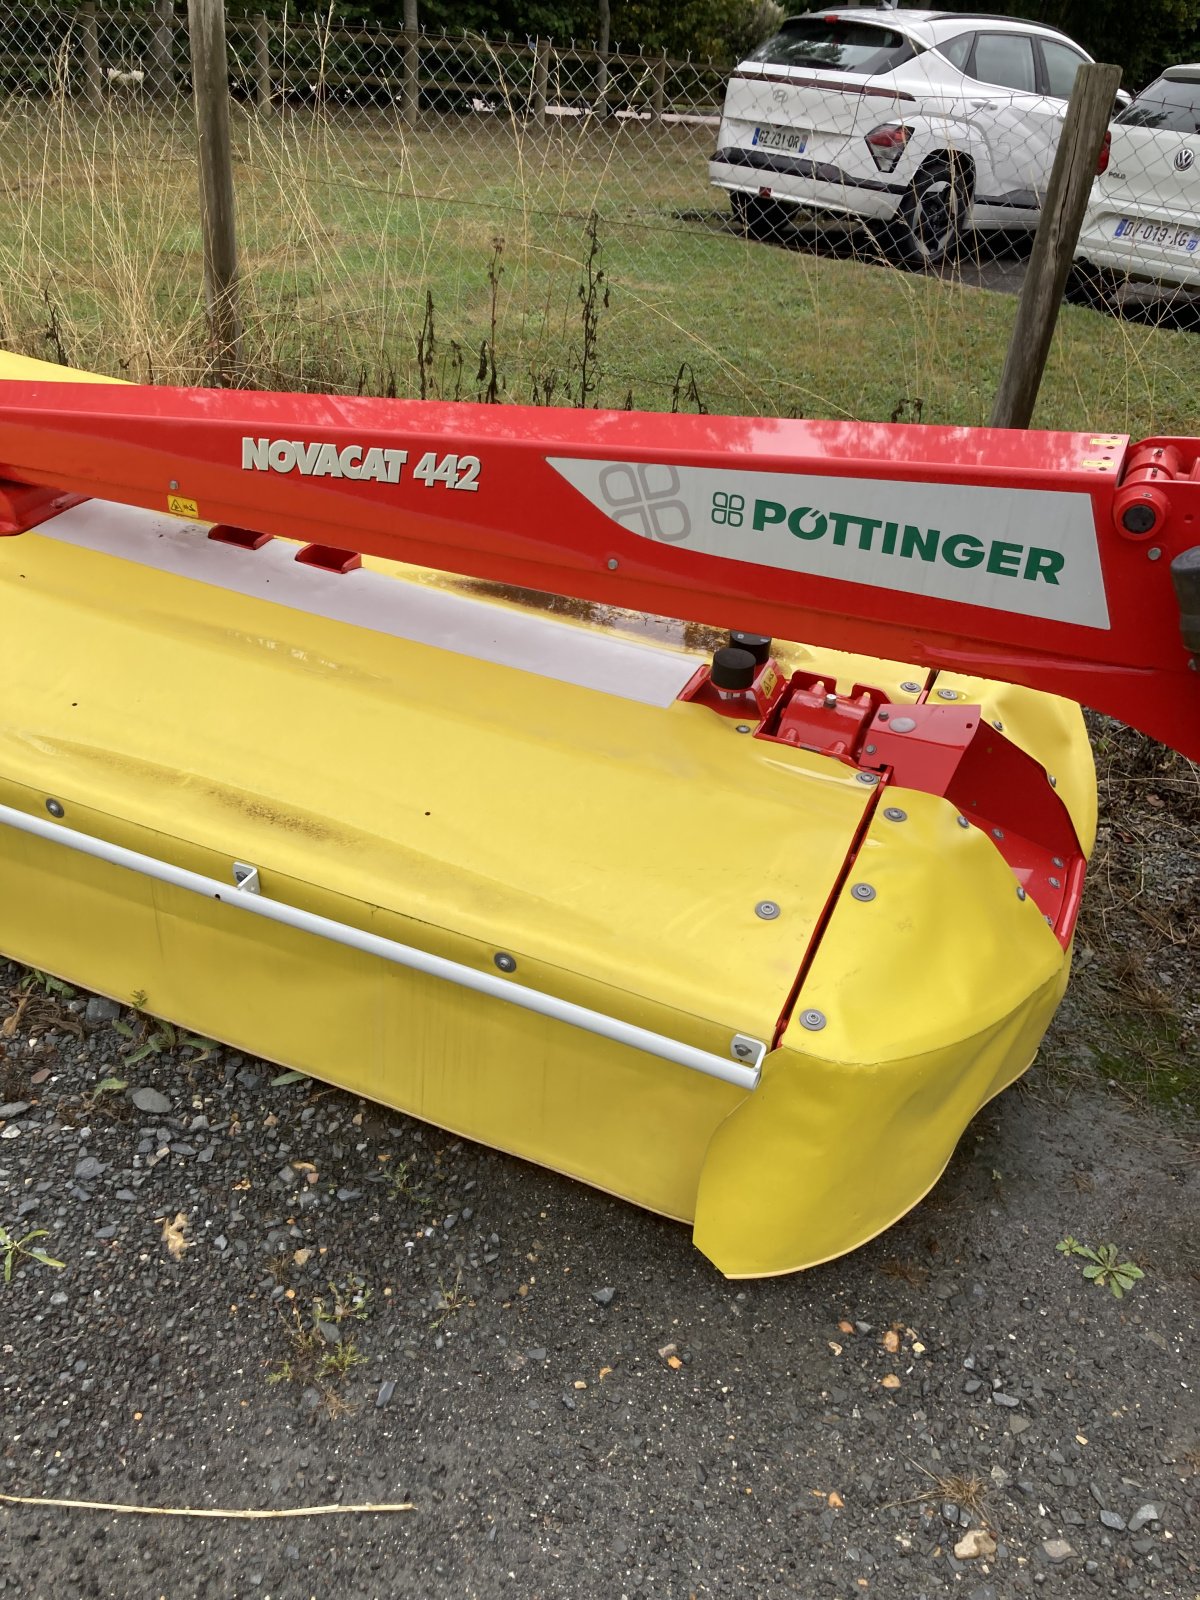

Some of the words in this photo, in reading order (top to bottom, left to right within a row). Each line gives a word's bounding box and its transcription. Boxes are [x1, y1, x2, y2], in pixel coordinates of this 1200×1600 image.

[1108, 171, 1126, 180] POLO
[241, 436, 408, 484] NOVACAT
[413, 452, 481, 491] 442
[752, 498, 1065, 586] PÖTTINGER
